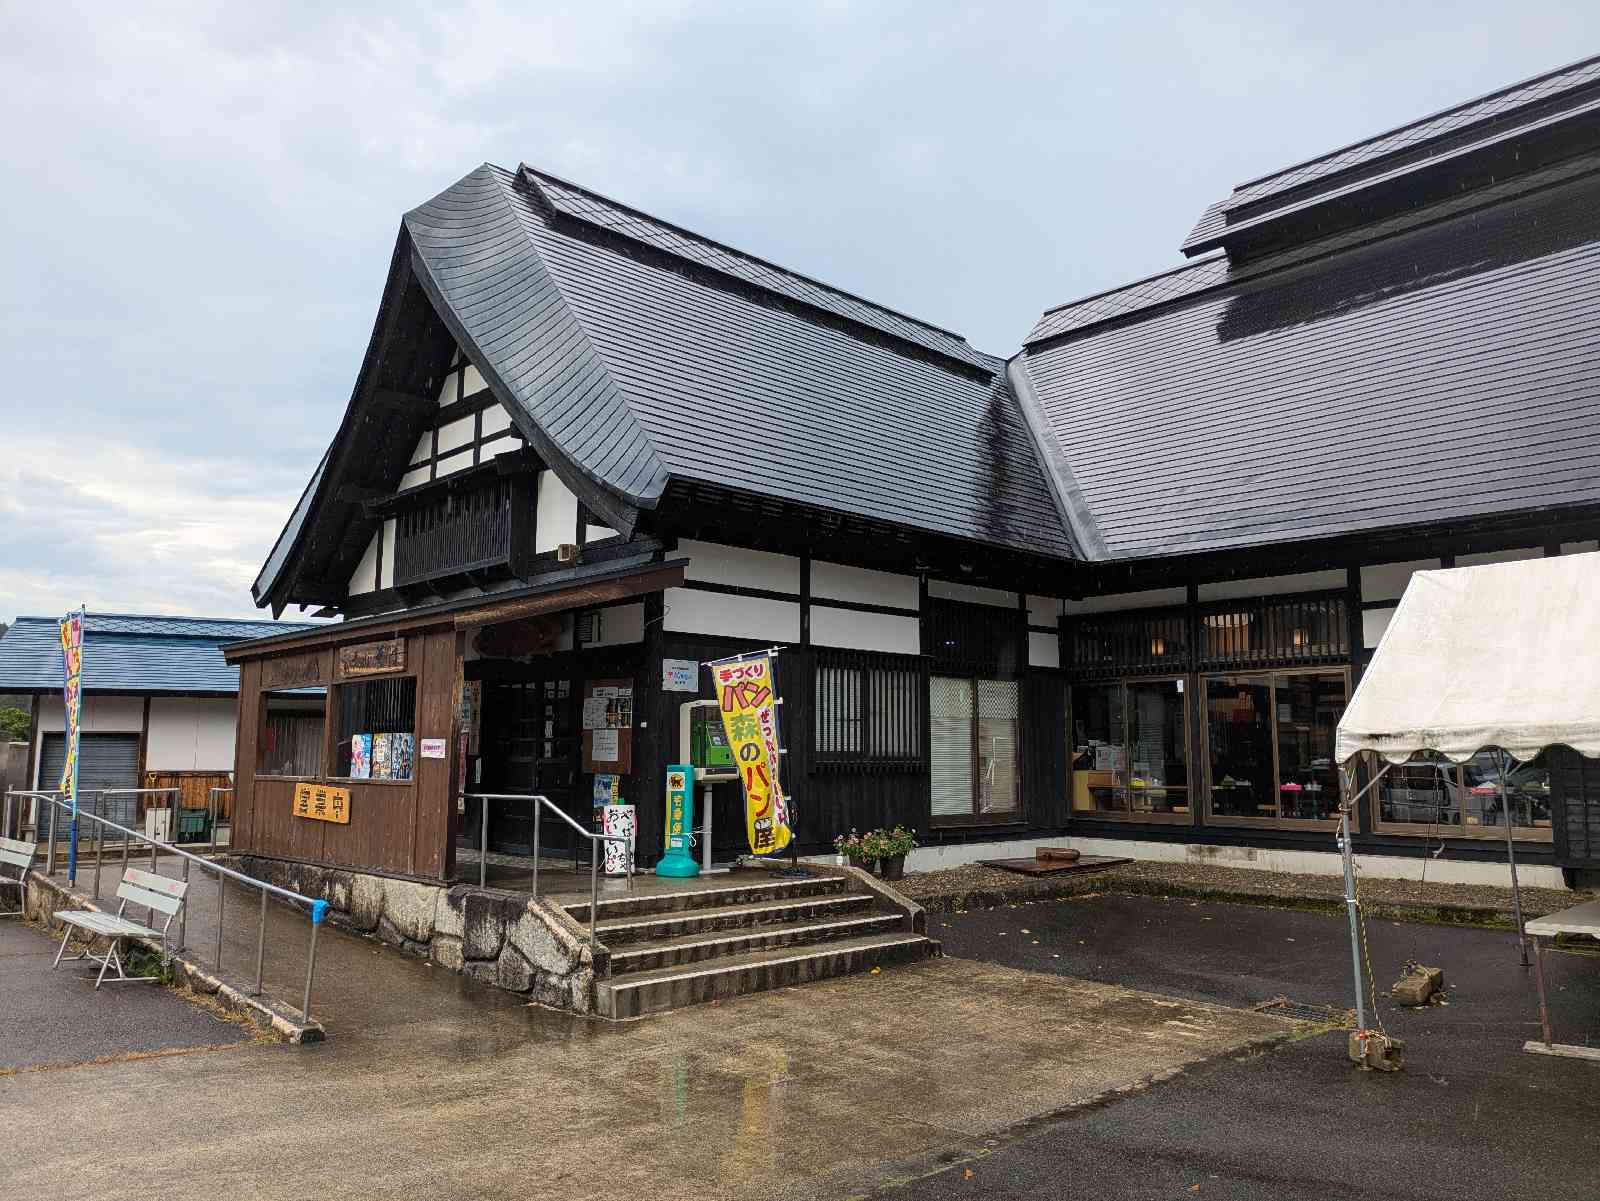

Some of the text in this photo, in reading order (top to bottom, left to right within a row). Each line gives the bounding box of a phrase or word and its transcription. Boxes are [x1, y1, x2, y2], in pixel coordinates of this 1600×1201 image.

[719, 664, 765, 682] 手づくり
[722, 682, 771, 712] パン
